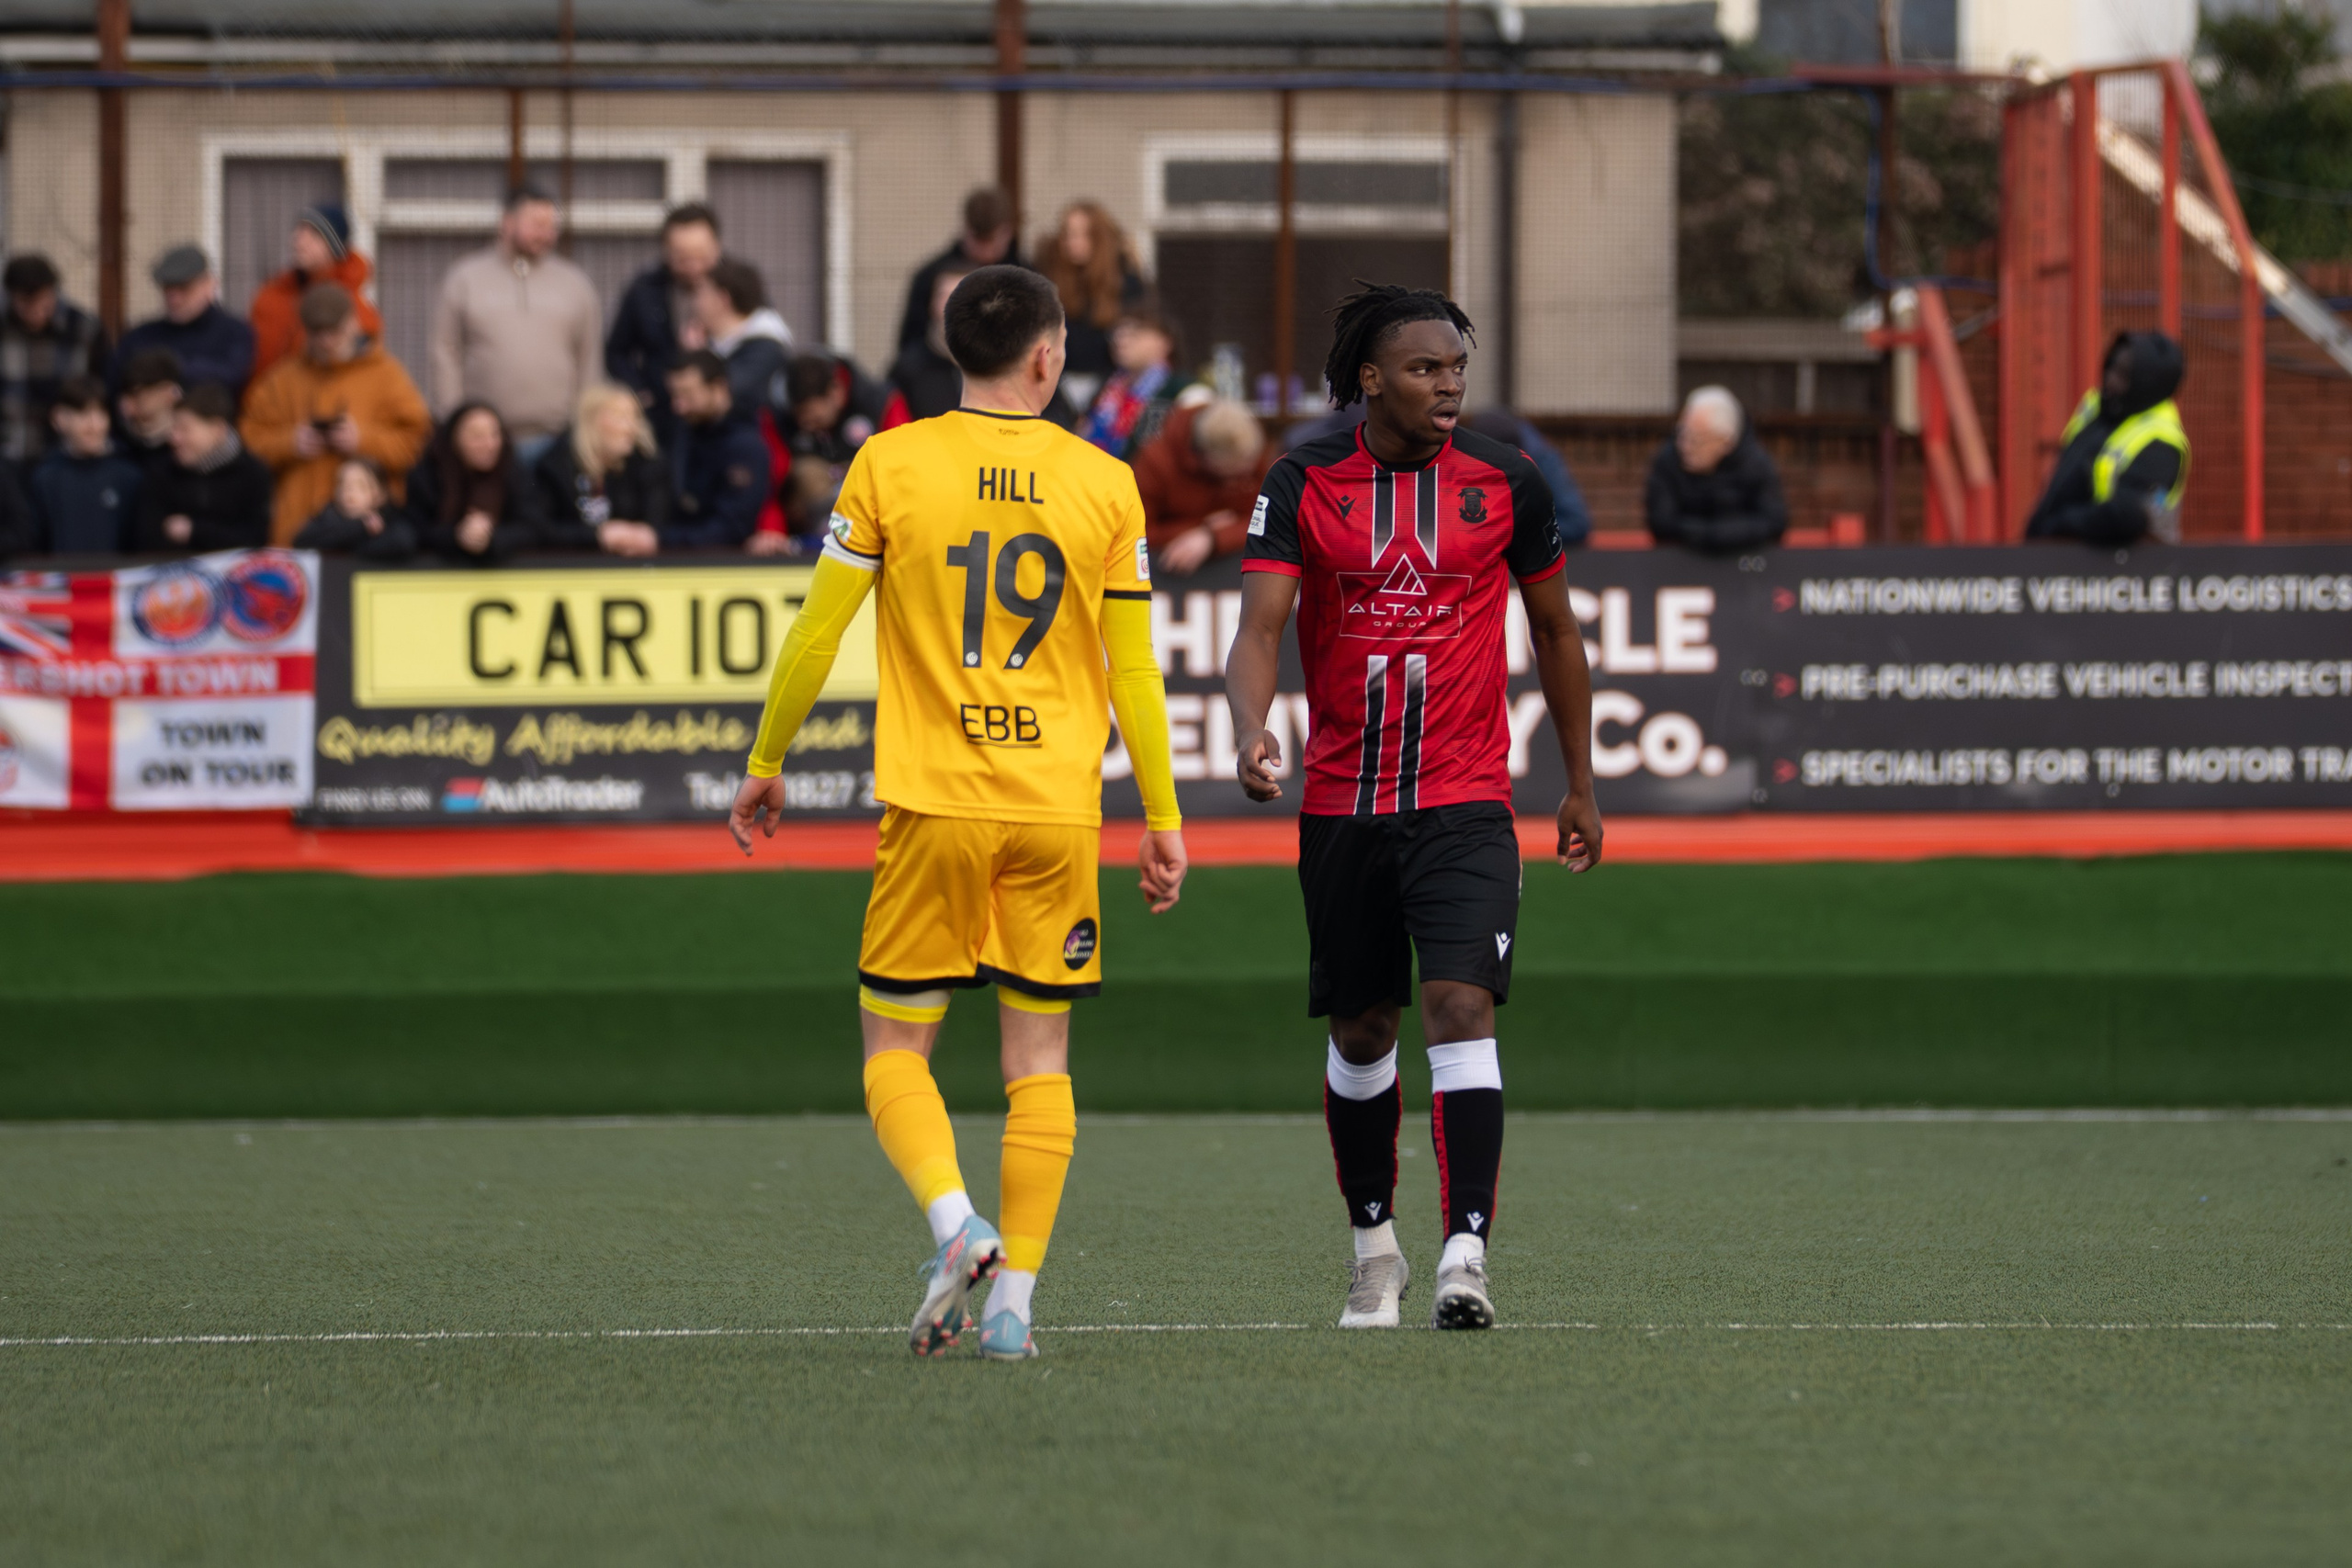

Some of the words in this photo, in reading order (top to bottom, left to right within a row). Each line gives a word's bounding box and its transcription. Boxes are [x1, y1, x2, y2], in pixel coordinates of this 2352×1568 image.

[978, 466, 1045, 504] HILL
[946, 530, 1068, 670] 19
[1800, 576, 2022, 615] NATIONWIDE
[2029, 575, 2173, 614] VEHICLE
[2178, 574, 2352, 613] LOGISTICS
[467, 595, 649, 682] CAR
[157, 659, 277, 690] TOWN
[1801, 661, 2058, 700] PRE-PURCHASE
[2064, 660, 2209, 698] VEHICLE
[160, 719, 267, 748] TOWN
[319, 716, 494, 765] Quality
[505, 709, 752, 765] Affordable
[788, 706, 869, 756] sed
[959, 703, 1042, 743] EBB
[1591, 689, 1728, 778] Co.
[140, 759, 193, 787] ON
[204, 758, 296, 786] TOUR
[1802, 748, 2012, 786] SPECIALISTS
[2015, 747, 2090, 785] FOR
[2094, 747, 2162, 784] THE
[2166, 746, 2295, 784] MOTOR
[481, 776, 644, 812] AutoTrader
[784, 770, 856, 809] 1827
